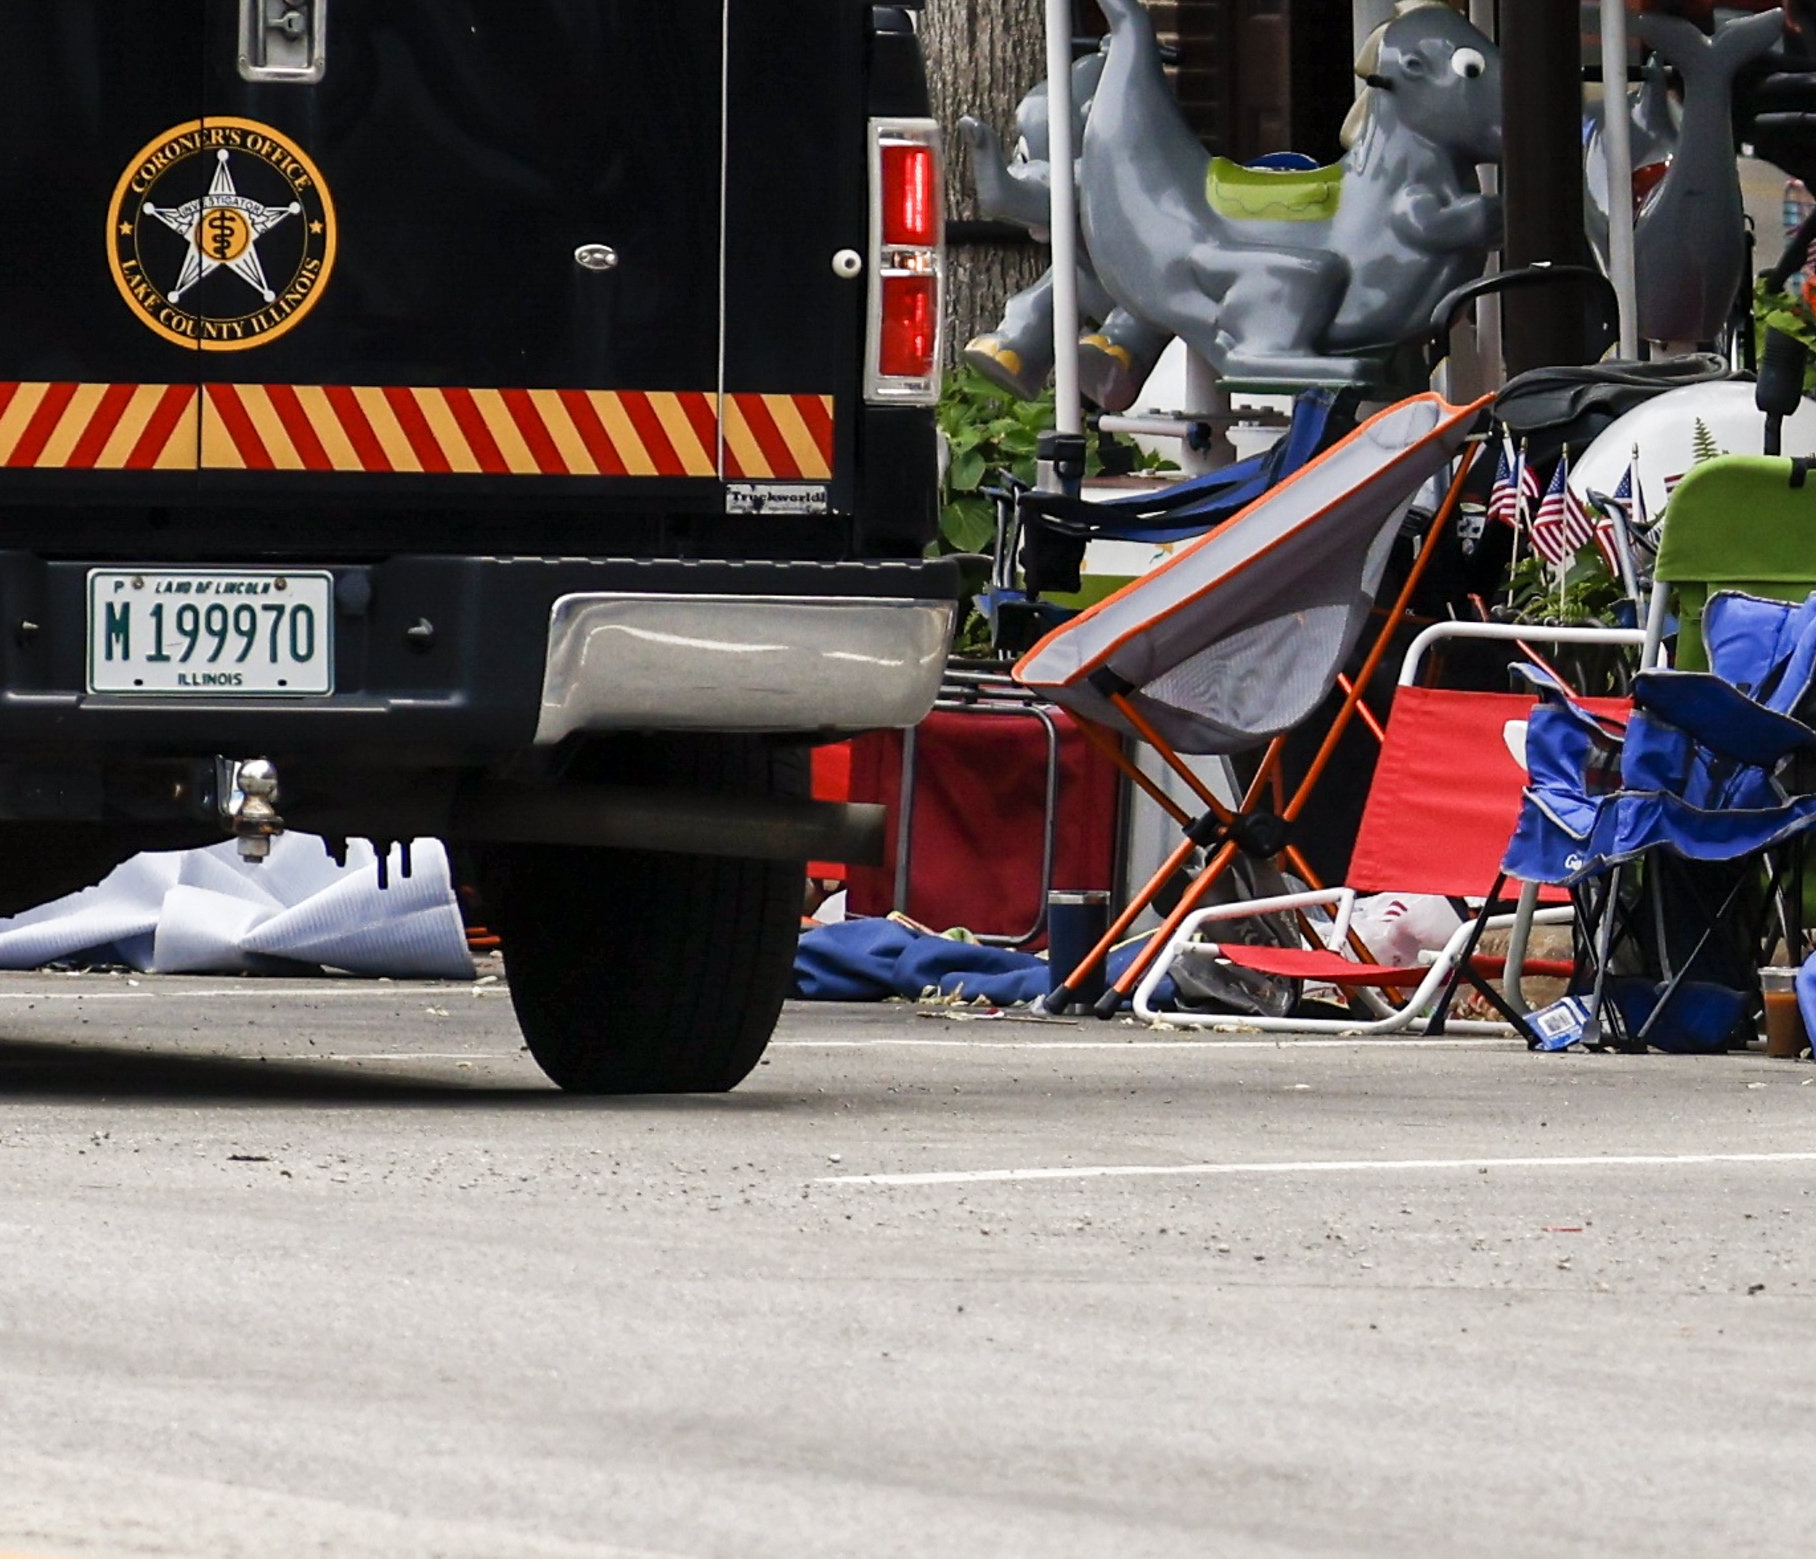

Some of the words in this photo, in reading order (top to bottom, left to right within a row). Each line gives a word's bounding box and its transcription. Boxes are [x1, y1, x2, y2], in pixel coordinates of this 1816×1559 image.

[131, 128, 242, 194] CORONER'S
[246, 134, 313, 192] OFFICE
[122, 258, 162, 314] LAKE
[159, 306, 247, 340] COUNTY
[251, 256, 322, 334] ILLINOIS
[113, 580, 125, 593] P
[155, 580, 191, 594] LAND
[195, 581, 212, 594] OF
[215, 581, 271, 594] LINCOLN
[105, 601, 130, 661] M
[146, 602, 315, 663] 199970
[178, 672, 243, 686] ILLINOIS
